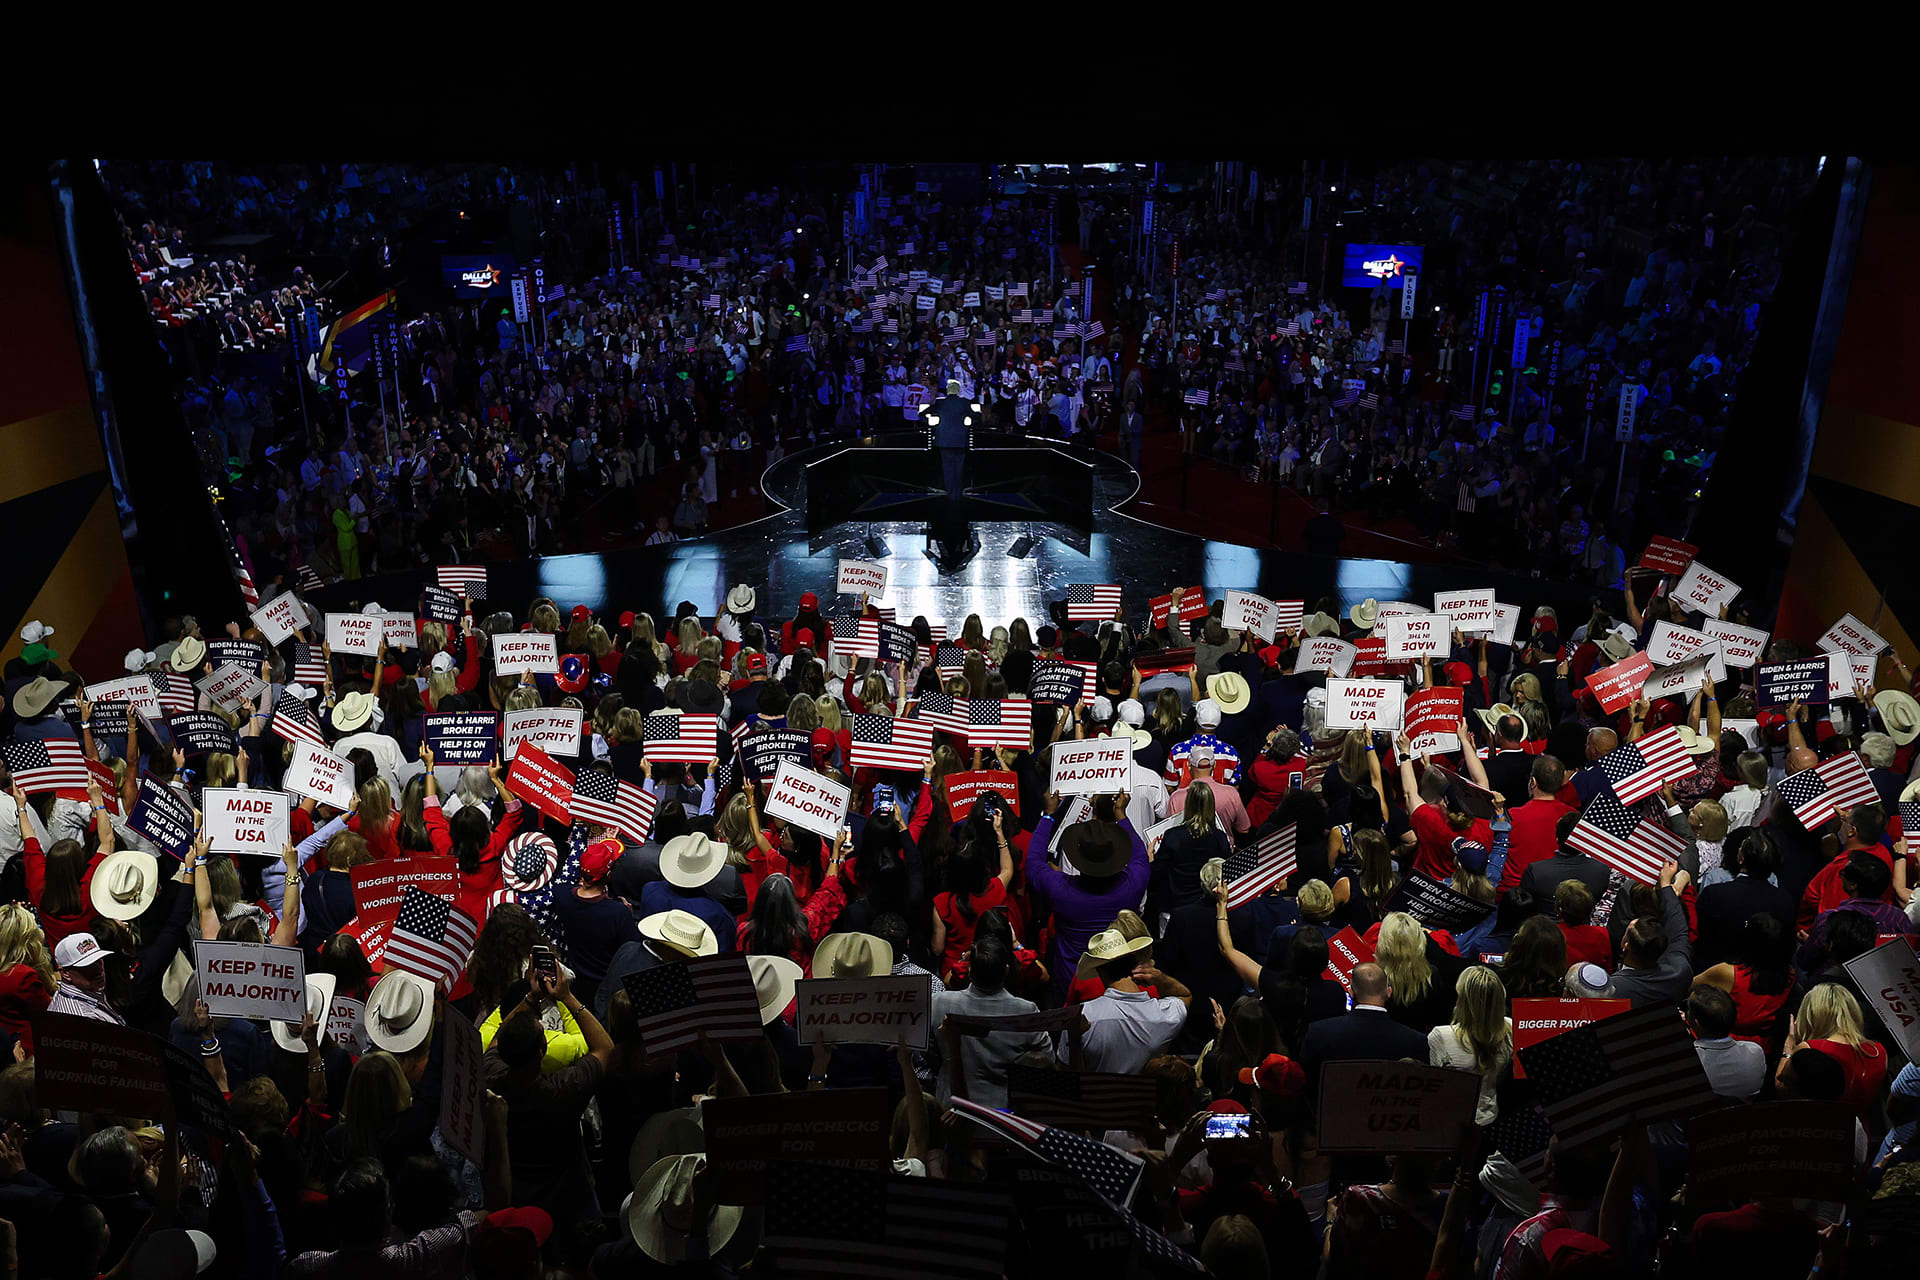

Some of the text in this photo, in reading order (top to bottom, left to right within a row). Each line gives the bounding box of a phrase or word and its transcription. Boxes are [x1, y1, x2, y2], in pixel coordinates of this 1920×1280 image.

[462, 272, 492, 280] DALLAS
[535, 268, 546, 303] OHIO
[515, 282, 524, 320] KENTUCKY
[1404, 278, 1412, 316] FLORIDA
[389, 322, 398, 366] HAWAII
[373, 333, 382, 378] DELAWARE
[1548, 340, 1562, 386] OREGON
[336, 356, 348, 400] IOWA
[1586, 362, 1600, 410] MAINE
[908, 393, 921, 405] 47
[1622, 388, 1633, 437] VERMONT
[844, 567, 883, 580] KEEP THE
[841, 578, 883, 590] MAJORITY
[1697, 573, 1725, 591] MADE
[1690, 590, 1708, 604] USA
[265, 600, 290, 620] MADE
[1240, 598, 1269, 614] MADE
[1440, 599, 1488, 610] KEEP THE
[280, 617, 297, 631] USA
[340, 619, 372, 630] MADE
[1242, 616, 1261, 628] USA
[1407, 622, 1430, 630] USA
[345, 637, 366, 647] USA
[1667, 631, 1703, 647] MADE
[1838, 623, 1876, 651] KEEP THE
[501, 643, 550, 651] KEEP THE
[1312, 642, 1344, 652] MADE
[1401, 642, 1436, 651] MADE
[1727, 647, 1754, 659] KEEP
[500, 655, 554, 664] MAJORITY
[1053, 667, 1082, 677] HARRIS
[1760, 662, 1826, 674] BIDEN HARRIS
[207, 681, 225, 695] KEEP
[224, 670, 242, 684] THE
[1662, 676, 1684, 689] USA
[1772, 673, 1801, 681] BROKE
[96, 686, 148, 701] KEEP THE
[217, 677, 255, 705] MAJORITY
[1049, 691, 1067, 700] WAY
[1059, 686, 1071, 694] ON
[1344, 688, 1385, 698] MADE
[1770, 685, 1790, 694] HELP
[1420, 699, 1459, 707] PAYCHECKS
[1774, 692, 1810, 702] THE WAY
[171, 715, 198, 725] BIDEN
[427, 717, 455, 726] BIDEN
[464, 716, 495, 724] HARRIS
[1350, 711, 1376, 720] USA
[189, 722, 217, 730] BROKE
[511, 719, 574, 731] KEEP THE
[189, 734, 210, 742] HELP
[214, 741, 230, 749] WAY
[508, 733, 576, 746] MAJORITY
[743, 733, 808, 748] BIDEN HARRIS
[1413, 738, 1436, 750] USA
[756, 743, 787, 752] BROKE
[309, 752, 343, 773] MADE
[518, 754, 543, 772] BIGGER
[755, 755, 776, 766] HELP
[1059, 750, 1124, 765] KEEP THE
[322, 770, 337, 780] THE
[759, 763, 776, 773] THE
[1055, 767, 1127, 781] MAJORITY
[145, 778, 166, 798] BIDEN
[309, 777, 333, 794] USA
[512, 771, 543, 793] WORKING
[538, 776, 553, 788] FOR
[950, 782, 1015, 792] BIGGER PAYCHECKS
[783, 775, 842, 807] KEEP THE
[153, 797, 178, 818] BROKE
[226, 799, 272, 814] MADE
[775, 791, 842, 823] MAJORITY
[145, 808, 186, 840] HELP ON
[235, 816, 264, 825] IN THE
[145, 821, 182, 847] THE WAY
[235, 829, 266, 842] USA
[358, 873, 452, 889] BIGGER PAYCHECKS
[1410, 876, 1442, 895] BIDEN
[1407, 900, 1434, 914] HELP
[1420, 891, 1456, 910] BROKE
[367, 934, 383, 950] FOR
[1333, 939, 1359, 965] BIGGER
[208, 960, 294, 979] KEEP THE
[206, 983, 302, 1002] MAJORITY
[810, 991, 917, 1005] KEEP THE
[1881, 987, 1914, 1026] USA
[805, 1012, 922, 1025] MAJORITY
[1518, 1020, 1557, 1029] BIGGER
[40, 1036, 87, 1050] BIGGER
[91, 1041, 160, 1066] PAYCHECKS
[91, 1059, 118, 1070] FOR
[44, 1069, 169, 1092] WORKING FAMILIES
[1357, 1073, 1444, 1092] MADE
[1370, 1096, 1423, 1107] IN THE
[1368, 1113, 1420, 1130] USA
[715, 1120, 880, 1138] BIGGER PAYCHECKS
[1750, 1128, 1848, 1141] PAYCHECKS
[782, 1140, 815, 1152] FOR
[1749, 1144, 1783, 1154] FOR
[1082, 1231, 1129, 1251] THE
